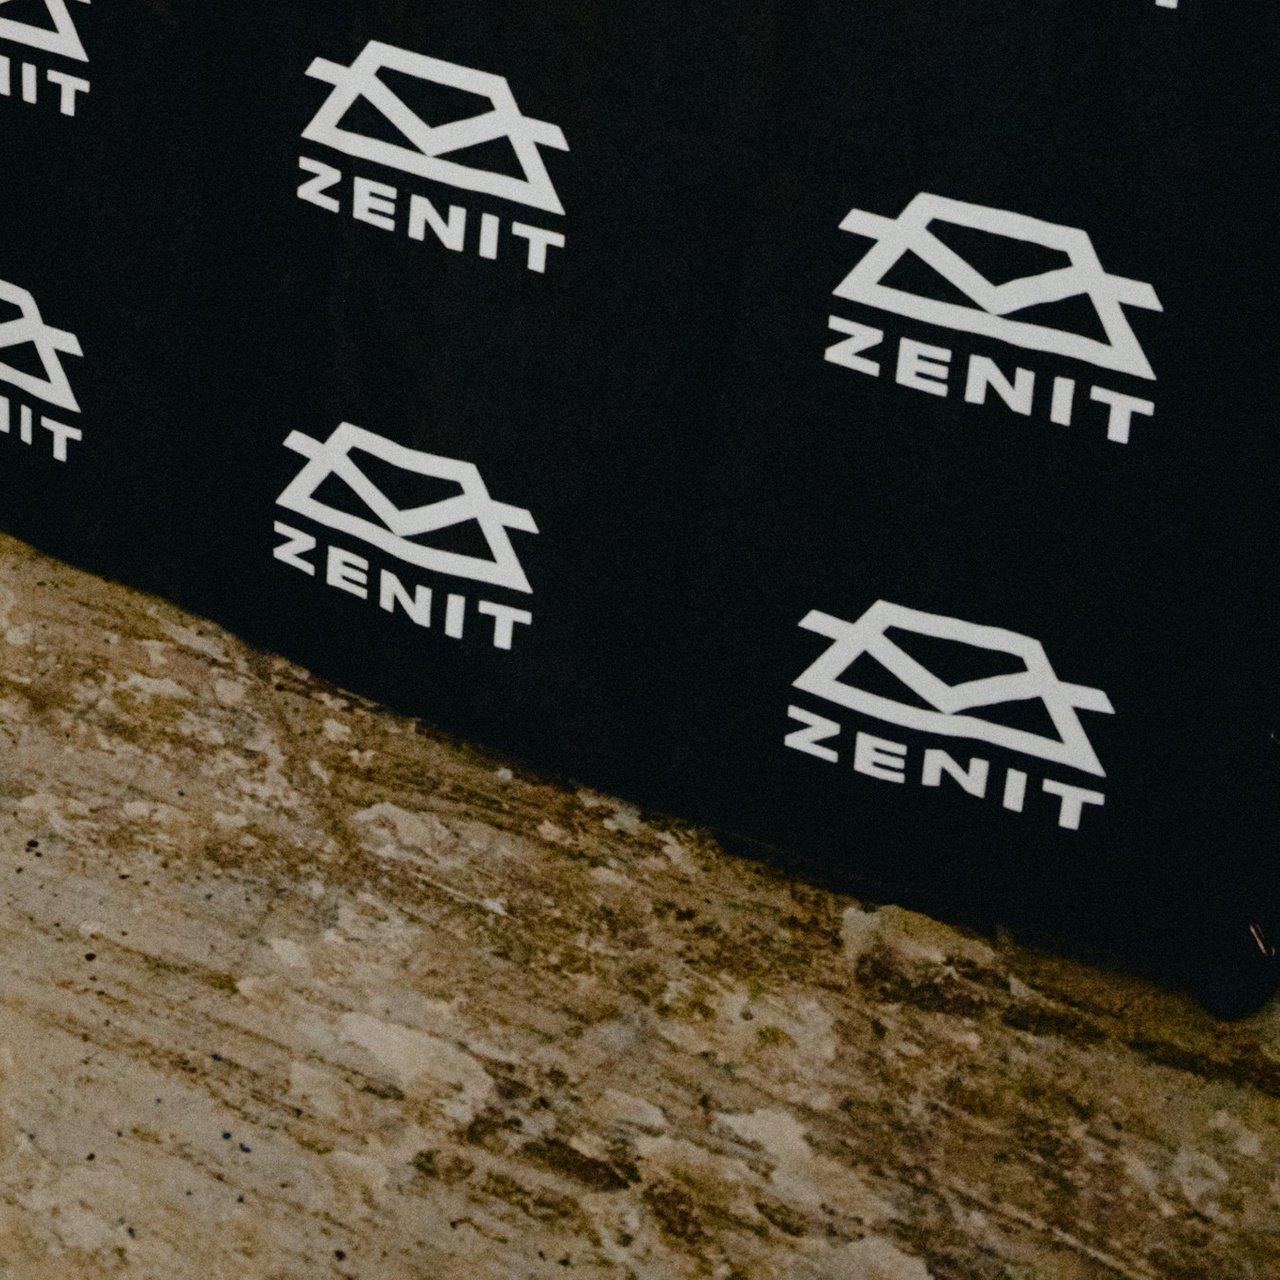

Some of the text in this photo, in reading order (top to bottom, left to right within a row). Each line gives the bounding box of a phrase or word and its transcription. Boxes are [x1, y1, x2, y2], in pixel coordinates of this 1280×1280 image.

[297, 156, 566, 273] ZENIT
[824, 315, 1155, 444] ZENIT
[273, 521, 532, 650] ZENIT
[783, 704, 1106, 830] ZENIT
